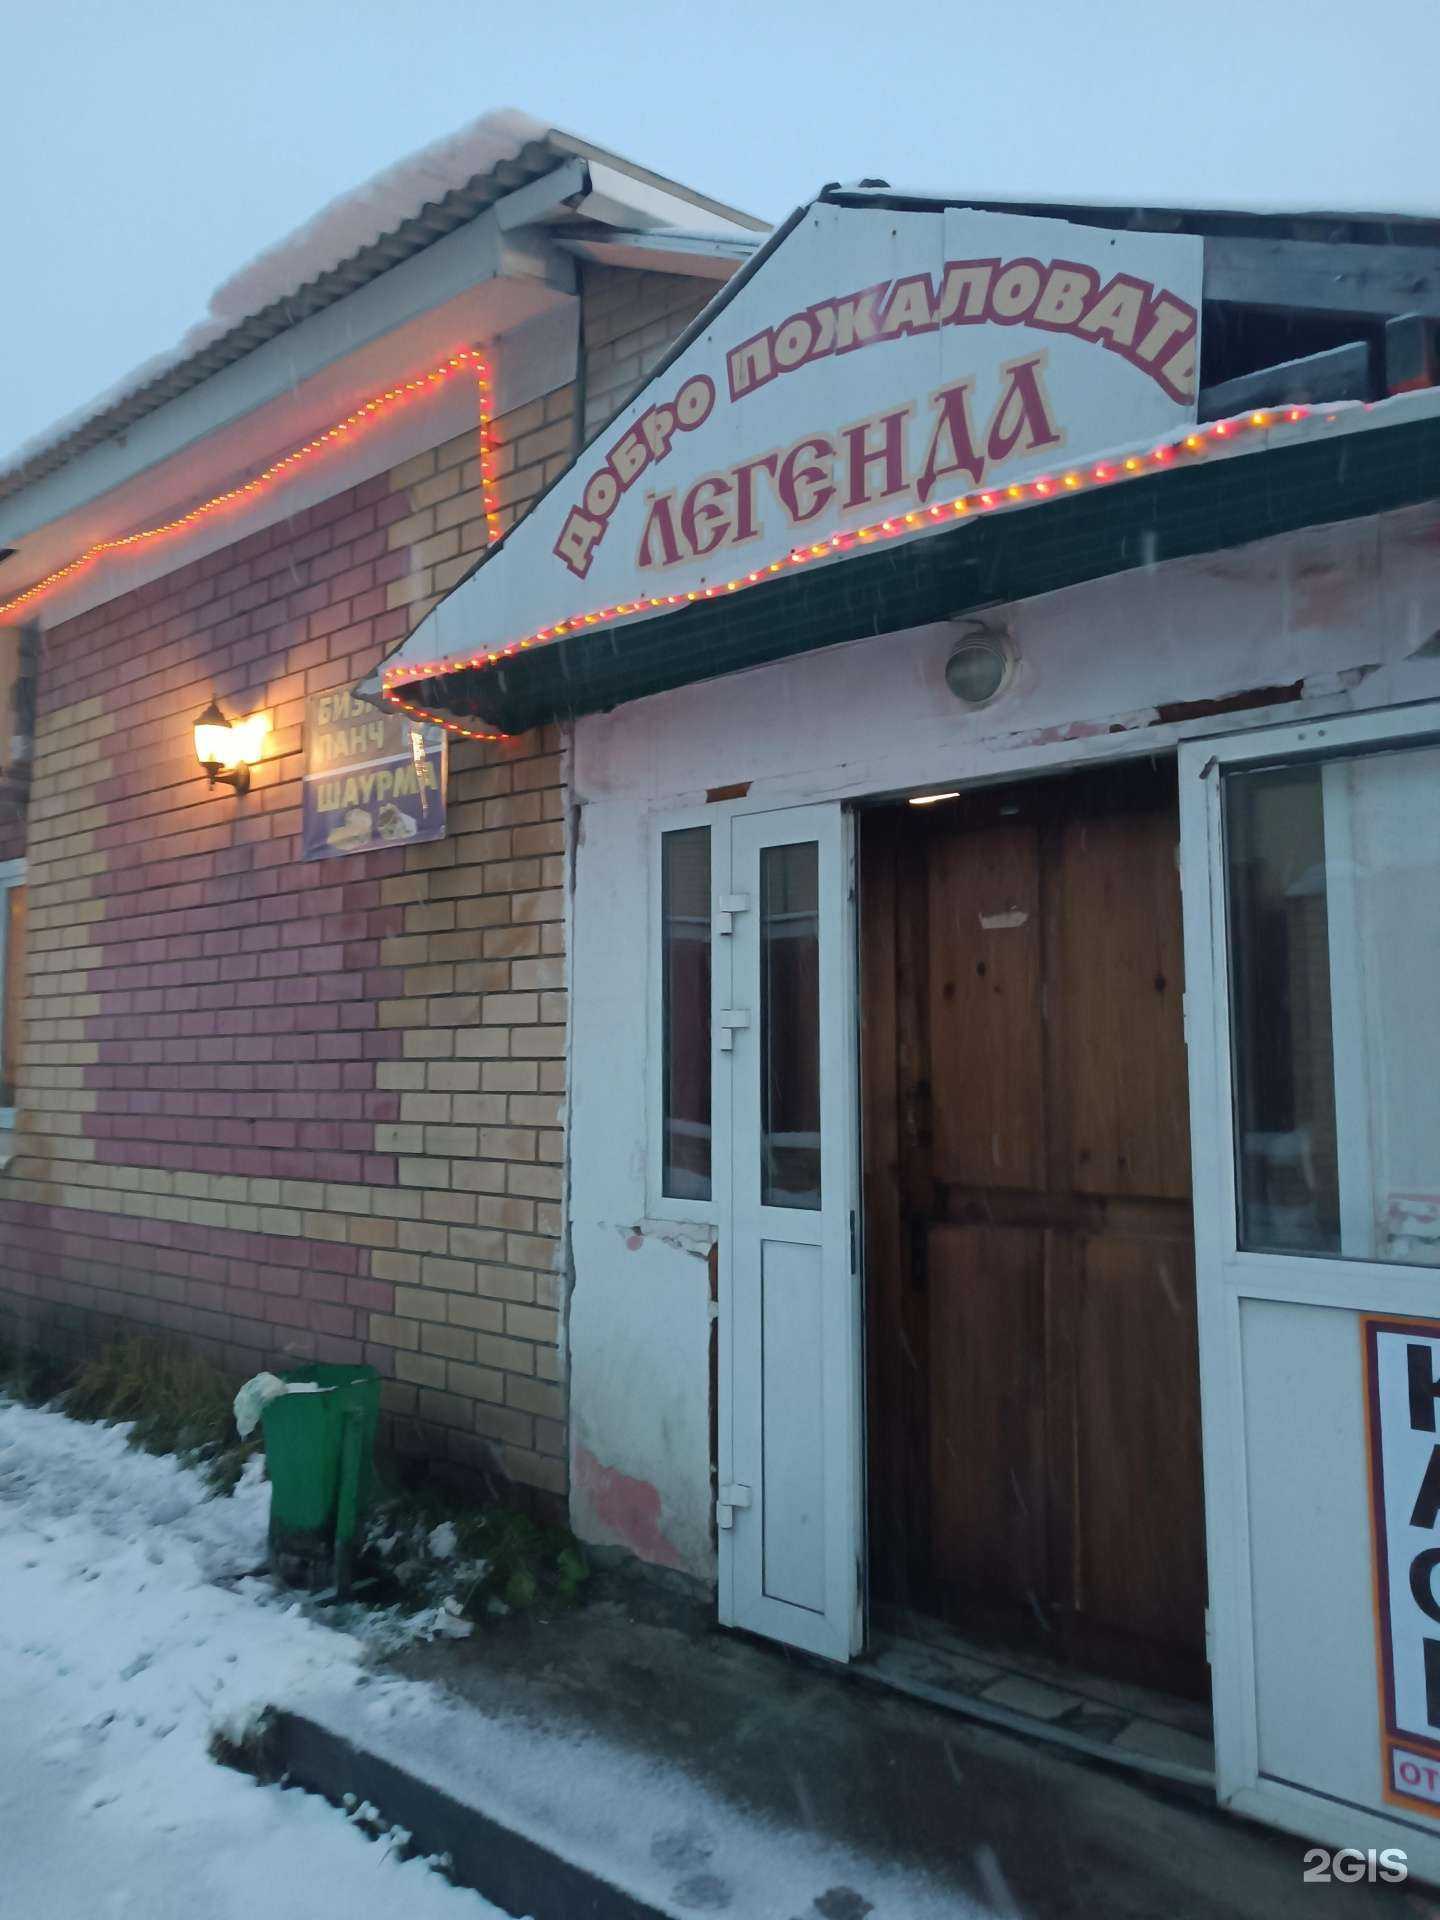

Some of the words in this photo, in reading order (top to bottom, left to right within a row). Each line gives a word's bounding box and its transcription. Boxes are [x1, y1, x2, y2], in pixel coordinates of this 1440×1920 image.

[554, 375, 715, 579] ДОБРО
[637, 350, 1063, 567] ЛЕГЕНДА
[318, 688, 378, 726] БИЗ
